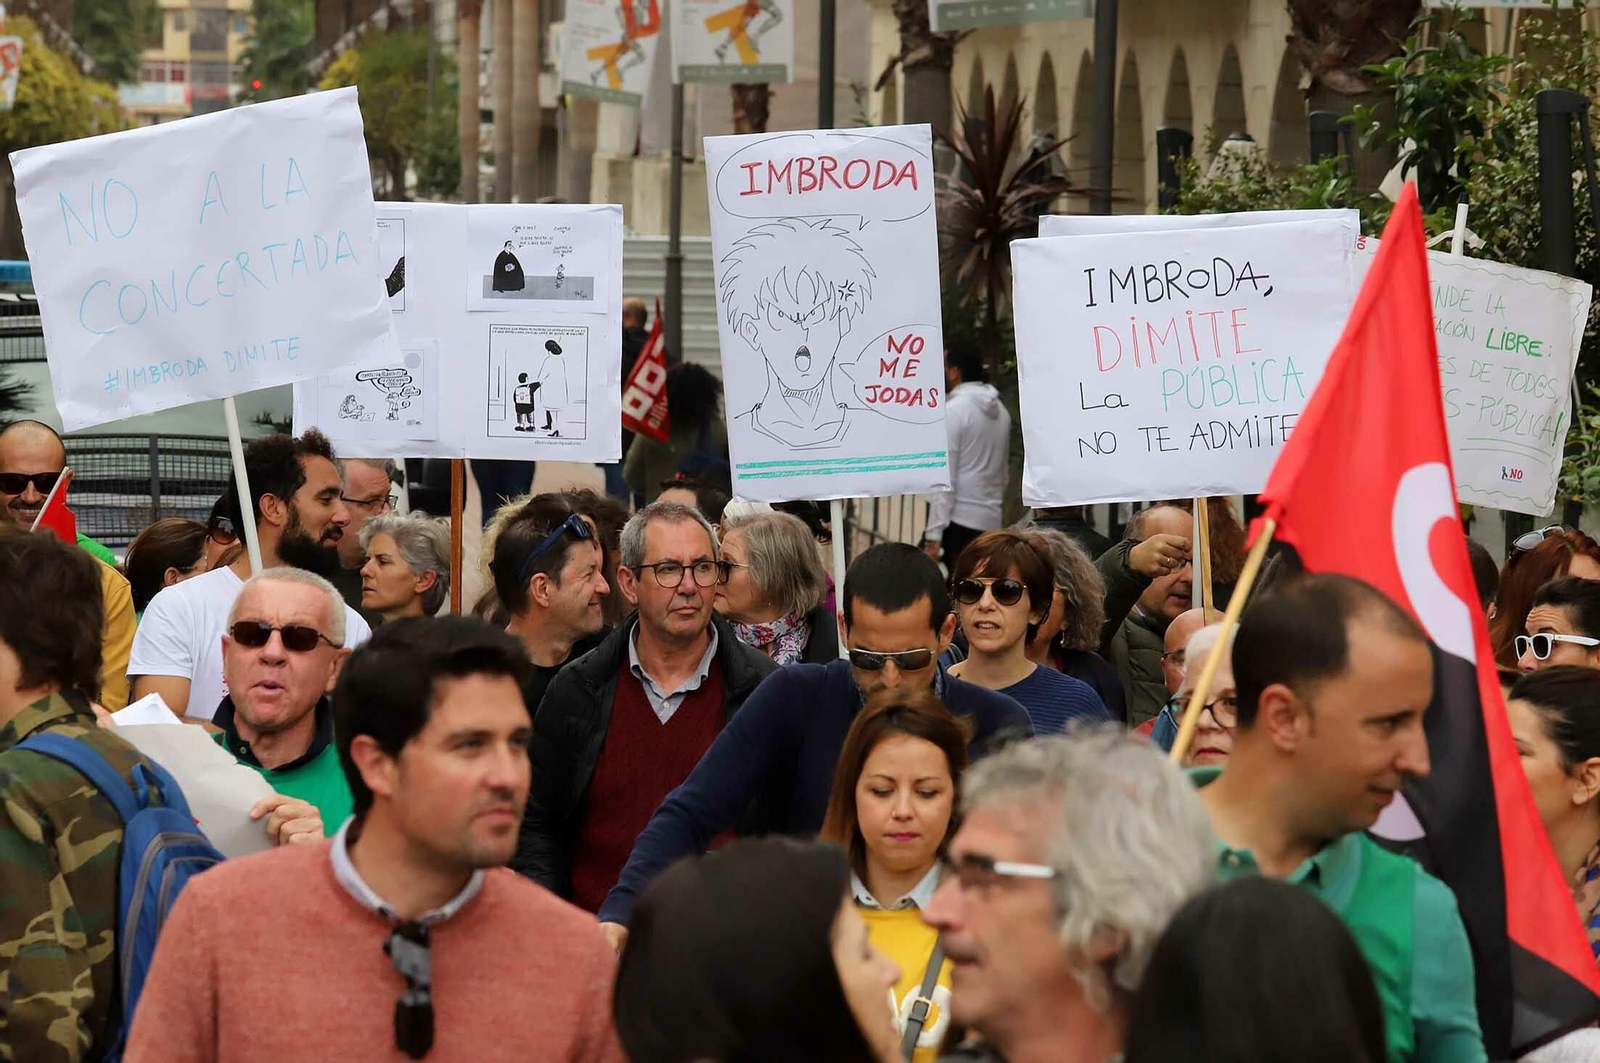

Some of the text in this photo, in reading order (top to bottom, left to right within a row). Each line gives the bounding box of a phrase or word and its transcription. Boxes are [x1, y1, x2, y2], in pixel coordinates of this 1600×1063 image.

[739, 156, 918, 196] IMBRODA
[58, 157, 311, 246] NO A LA
[79, 230, 360, 335] CONCERTADA
[1485, 292, 1506, 319] LA
[887, 332, 925, 355] NO
[104, 337, 300, 391] #IMBRODA DIMITE
[879, 356, 922, 378] ME
[1468, 358, 1494, 383] DE
[865, 384, 939, 408] JODAS
[1079, 382, 1130, 411] La
[1077, 430, 1118, 459] NO
[1138, 425, 1179, 452] TE
[1509, 468, 1524, 480] NO
